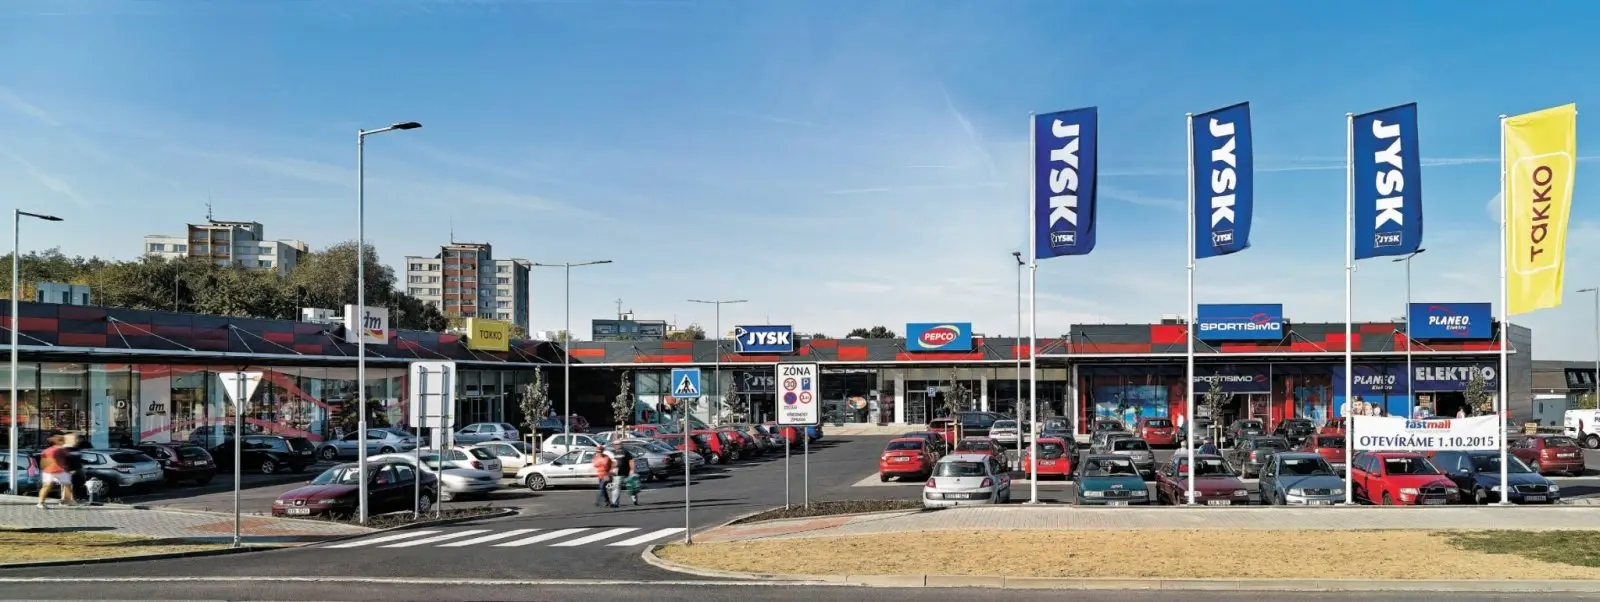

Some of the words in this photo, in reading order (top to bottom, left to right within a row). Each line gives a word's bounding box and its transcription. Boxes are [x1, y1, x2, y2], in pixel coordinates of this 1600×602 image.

[1049, 118, 1080, 229] JYSK
[1211, 117, 1237, 228] JYSK
[1372, 119, 1404, 229] JYSK
[1054, 233, 1074, 243] JYSK
[1215, 233, 1232, 242] JYSK
[1378, 235, 1400, 243] JYSK
[1200, 322, 1280, 331] SPORTISIMO
[747, 331, 790, 345] JYSK
[924, 332, 954, 341] PEPCO
[783, 366, 811, 376] ZÓNA
[1415, 366, 1495, 381] ELEKTRO
[752, 376, 774, 386] JYS
[149, 400, 165, 412] dm
[1405, 419, 1451, 429] fastmall
[1360, 434, 1434, 447] OTEVÍRÁME
[1438, 436, 1494, 448] 1.10.2015
